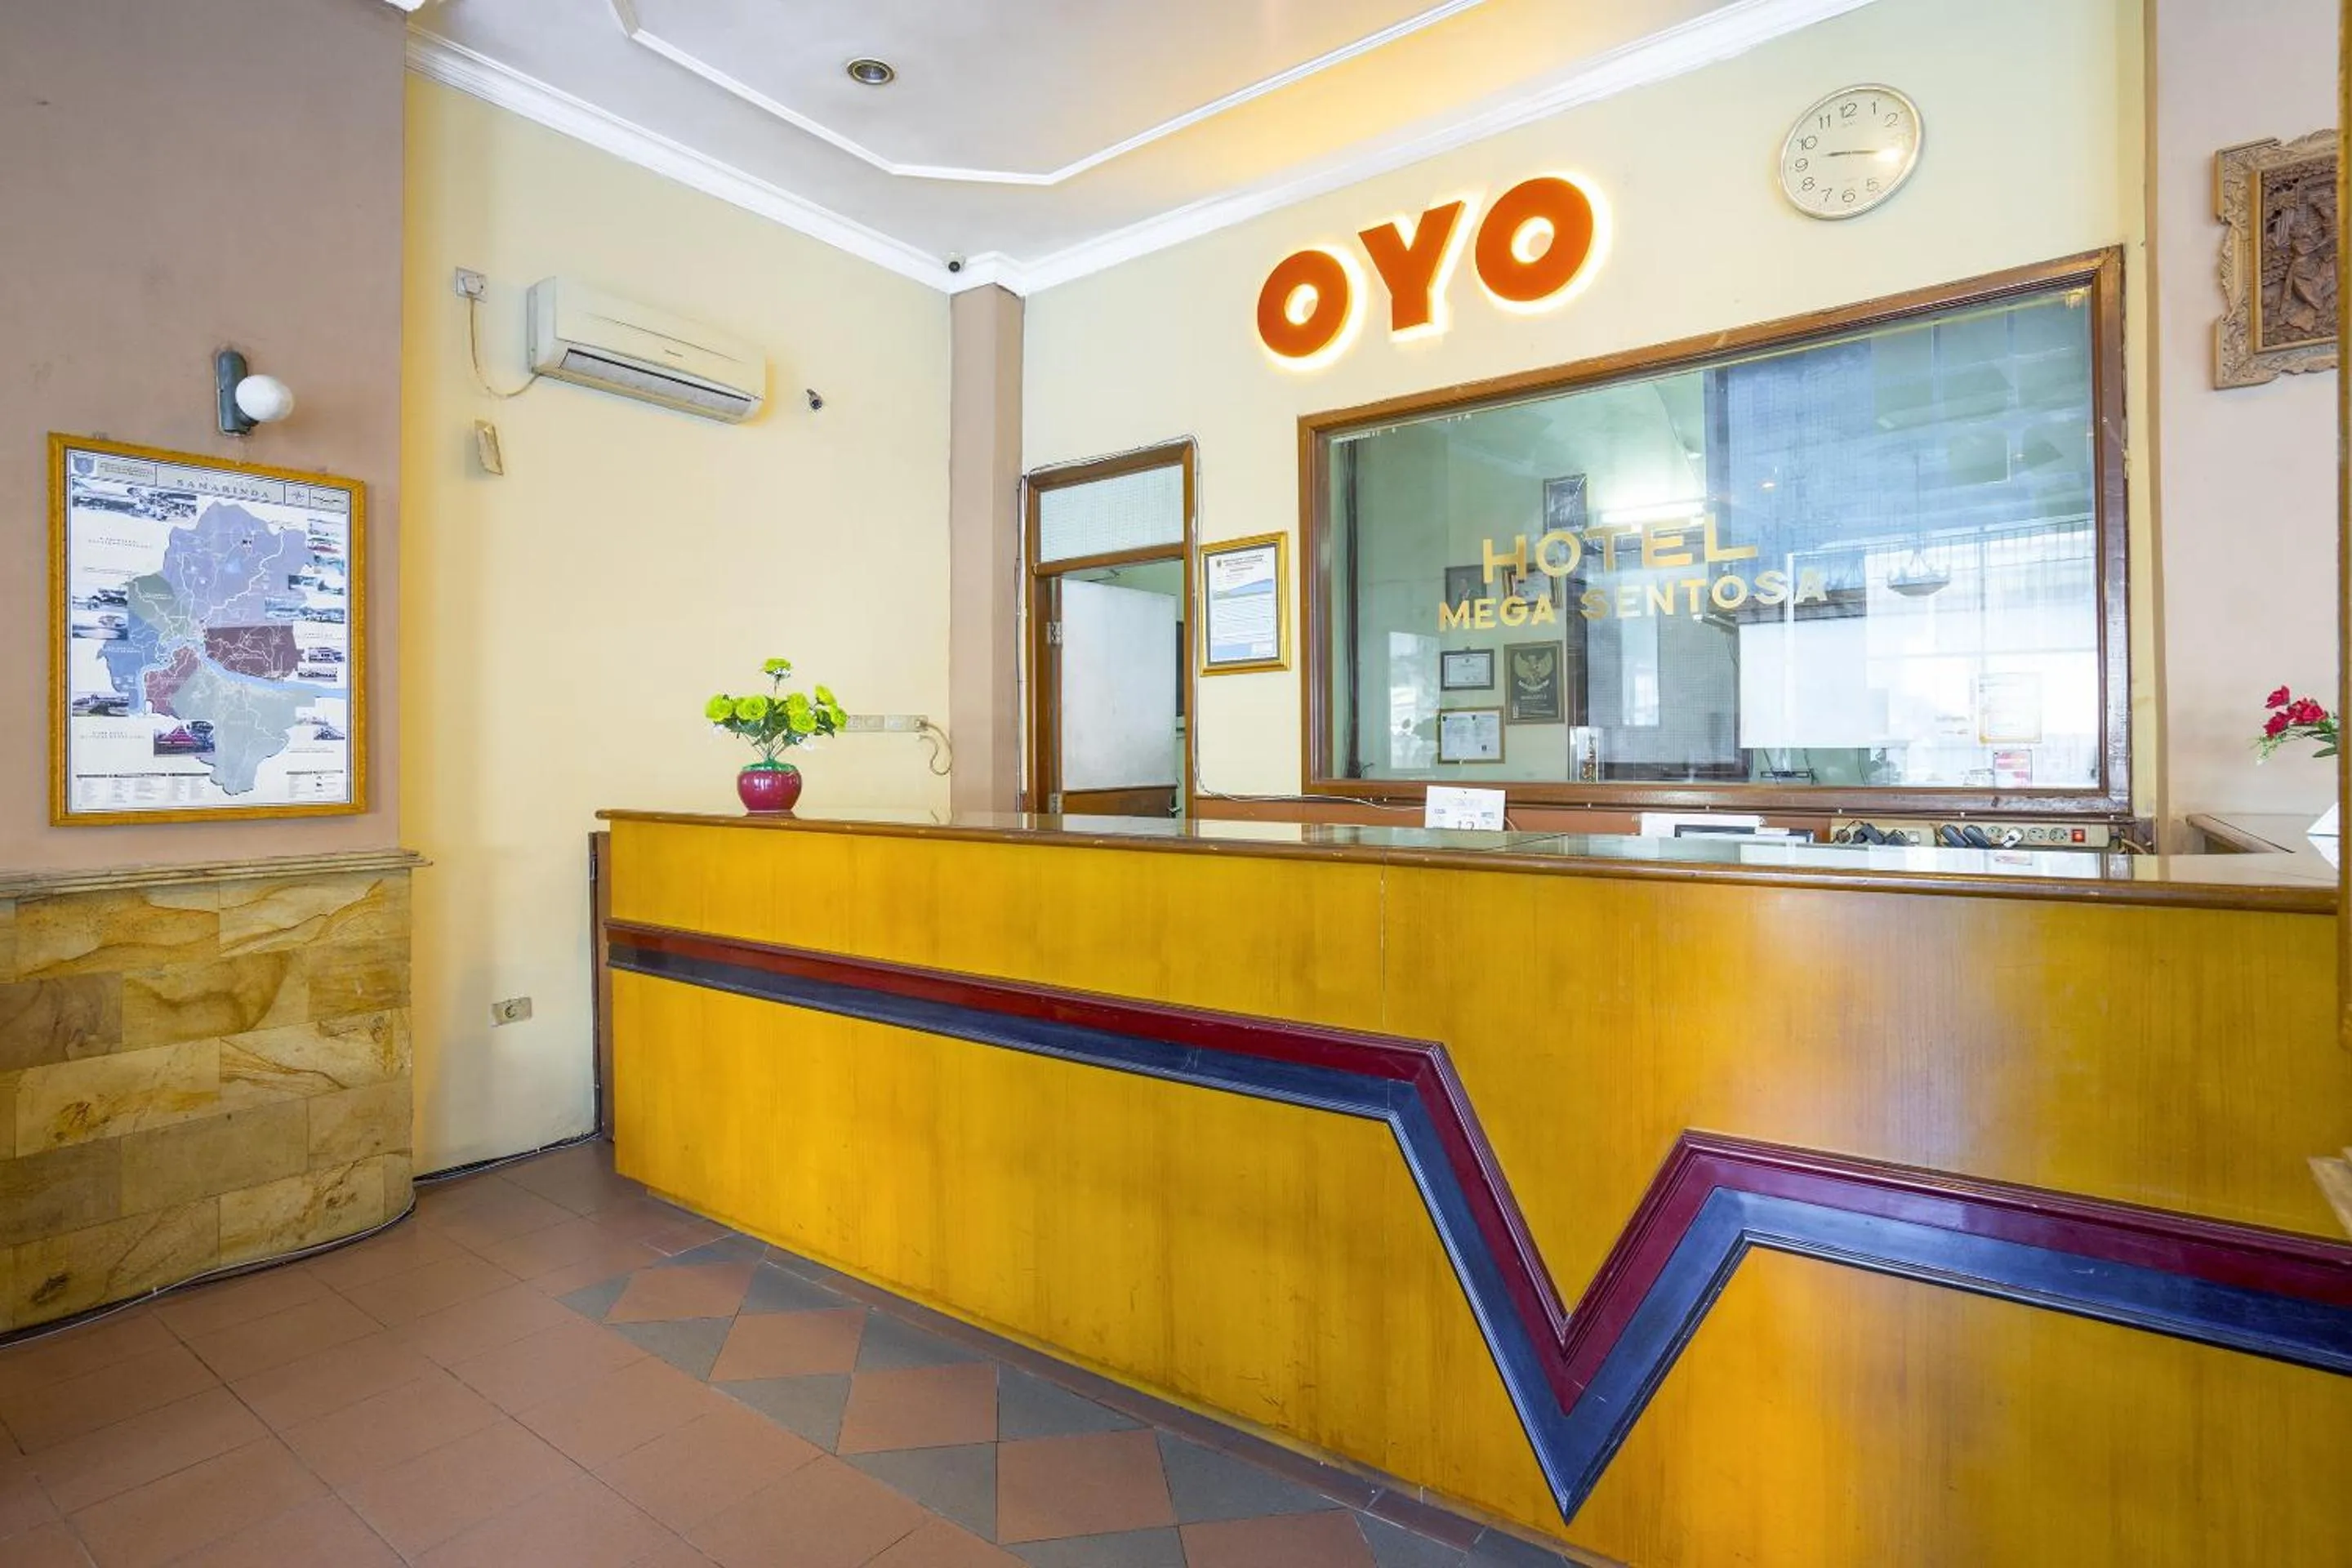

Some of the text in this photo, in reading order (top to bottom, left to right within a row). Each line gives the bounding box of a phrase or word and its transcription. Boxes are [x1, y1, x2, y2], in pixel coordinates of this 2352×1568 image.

[1839, 103, 1857, 118] 12
[1871, 101, 1877, 115] 1
[1819, 114, 1831, 129] 11
[1885, 112, 1899, 127] 2
[1797, 136, 1818, 150] 10
[1795, 158, 1808, 172] 9
[1802, 176, 1815, 191] 8
[1866, 177, 1879, 192] 5
[1821, 188, 1833, 202] 7
[1842, 189, 1855, 203] 6
[1258, 176, 1594, 358] OYO
[176, 478, 270, 498] SAMARINDA
[1482, 515, 1757, 584] HOTEL
[1437, 570, 1828, 632] MEGA SENTOSA
